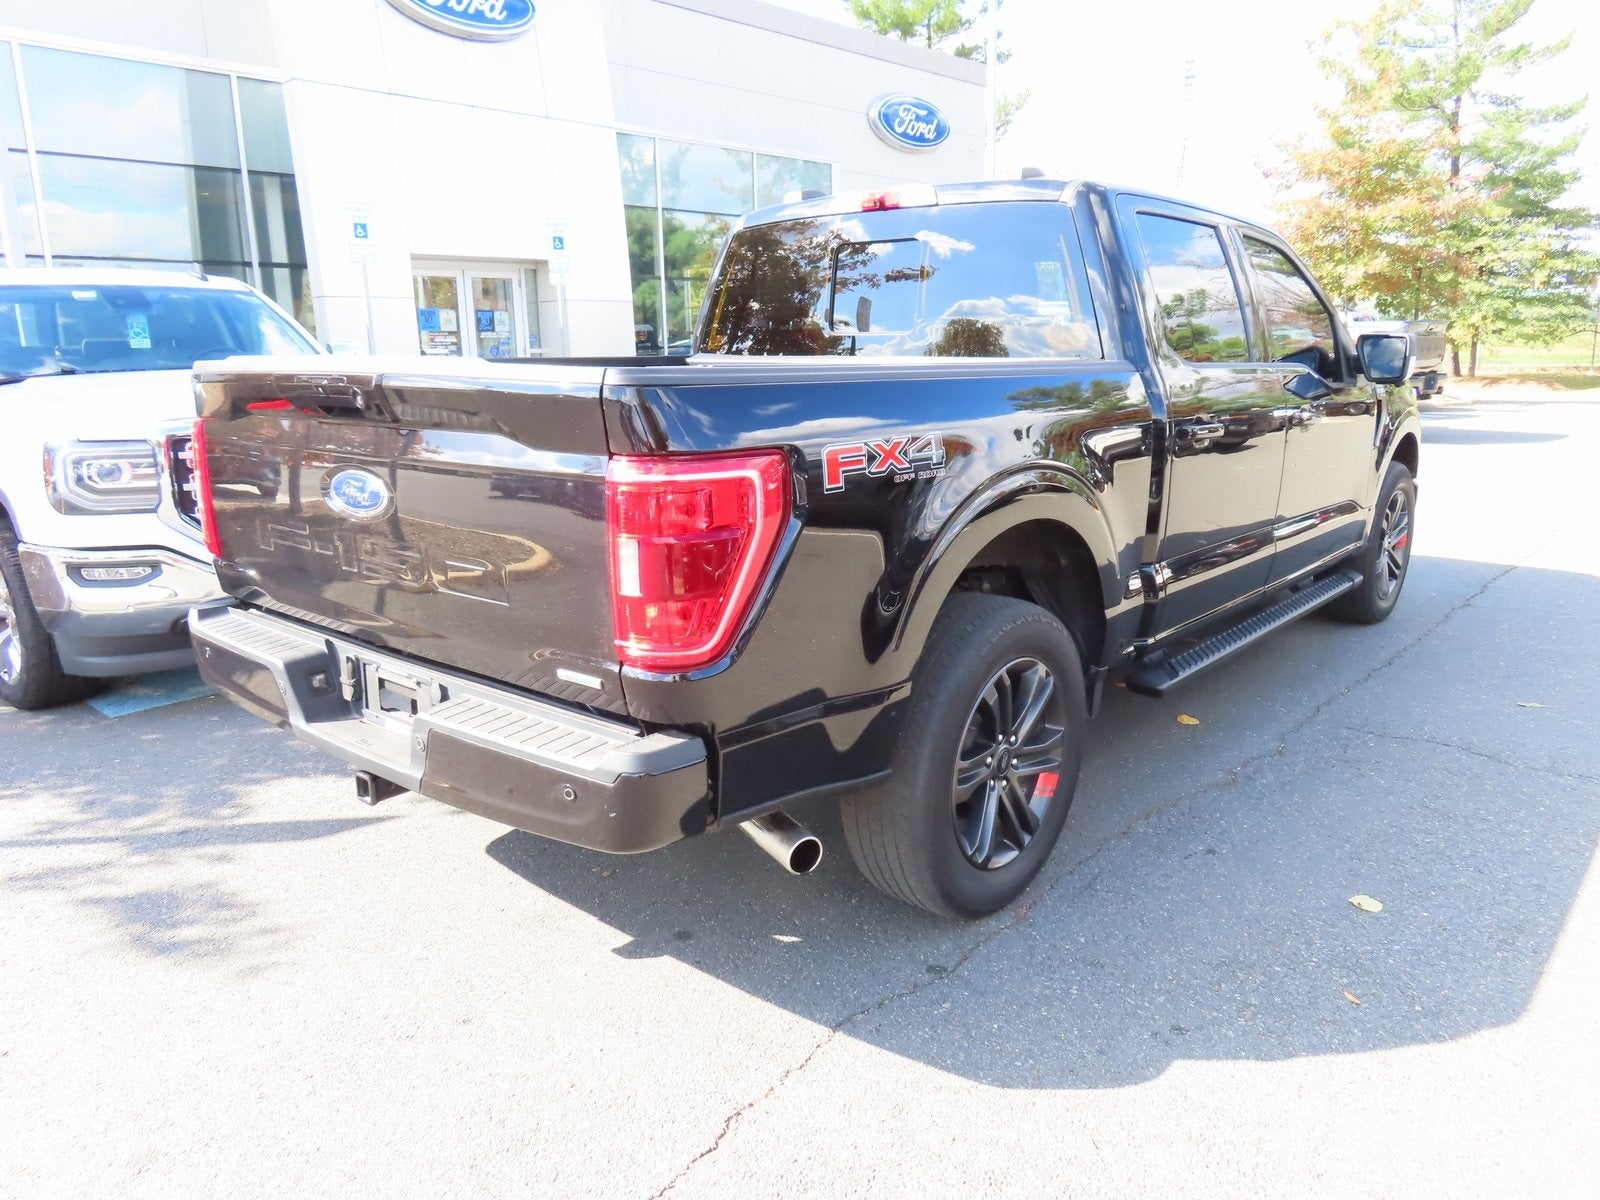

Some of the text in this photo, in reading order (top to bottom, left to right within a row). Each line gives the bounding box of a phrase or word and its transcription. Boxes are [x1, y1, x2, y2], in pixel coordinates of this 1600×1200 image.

[426, 0, 507, 20] ord
[894, 104, 938, 139] Ford
[822, 432, 946, 494] FX4
[893, 468, 946, 483] OFF ROAD
[340, 478, 372, 507] Ford
